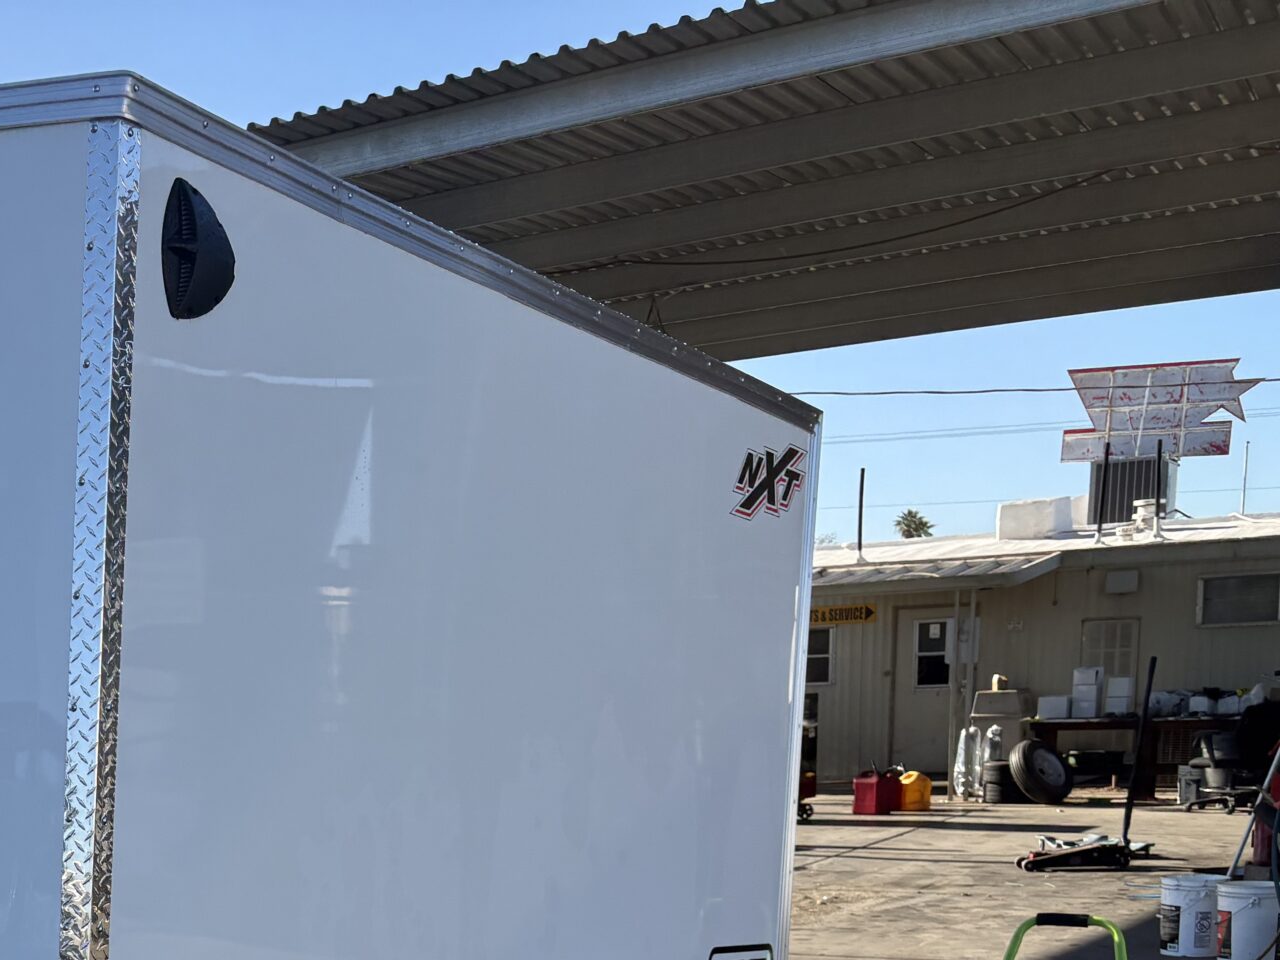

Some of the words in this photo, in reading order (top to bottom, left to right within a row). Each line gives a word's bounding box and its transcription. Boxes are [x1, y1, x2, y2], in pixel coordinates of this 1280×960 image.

[731, 445, 805, 519] NXT
[821, 610, 827, 622] &
[829, 606, 864, 622] SERVICE
